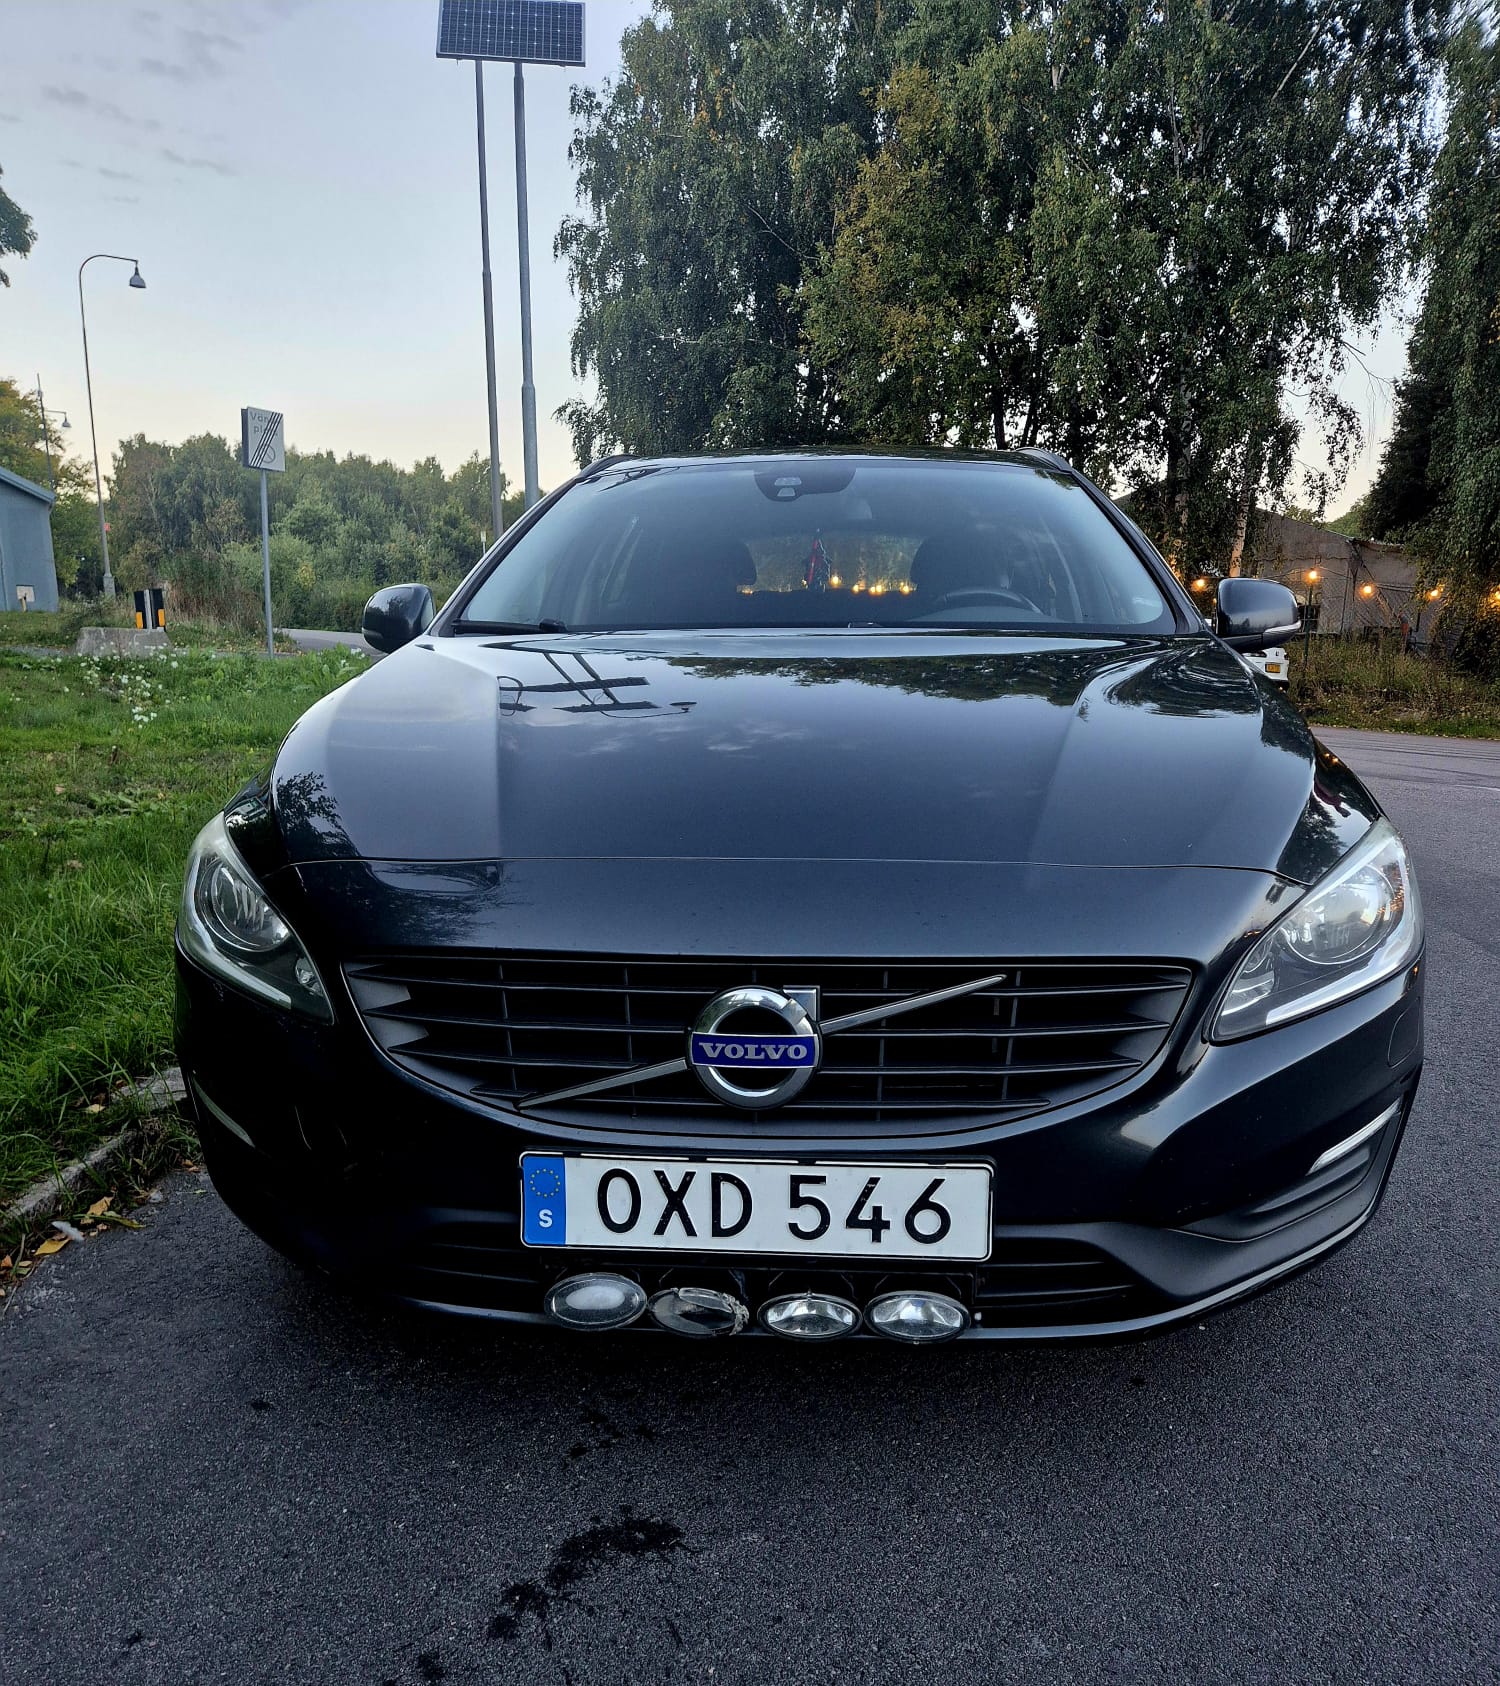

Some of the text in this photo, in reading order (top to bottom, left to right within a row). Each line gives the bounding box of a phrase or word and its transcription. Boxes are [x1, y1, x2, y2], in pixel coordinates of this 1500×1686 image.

[698, 1042, 808, 1060] VOLVO
[597, 1168, 952, 1244] OXD 546
[538, 1208, 553, 1228] S
